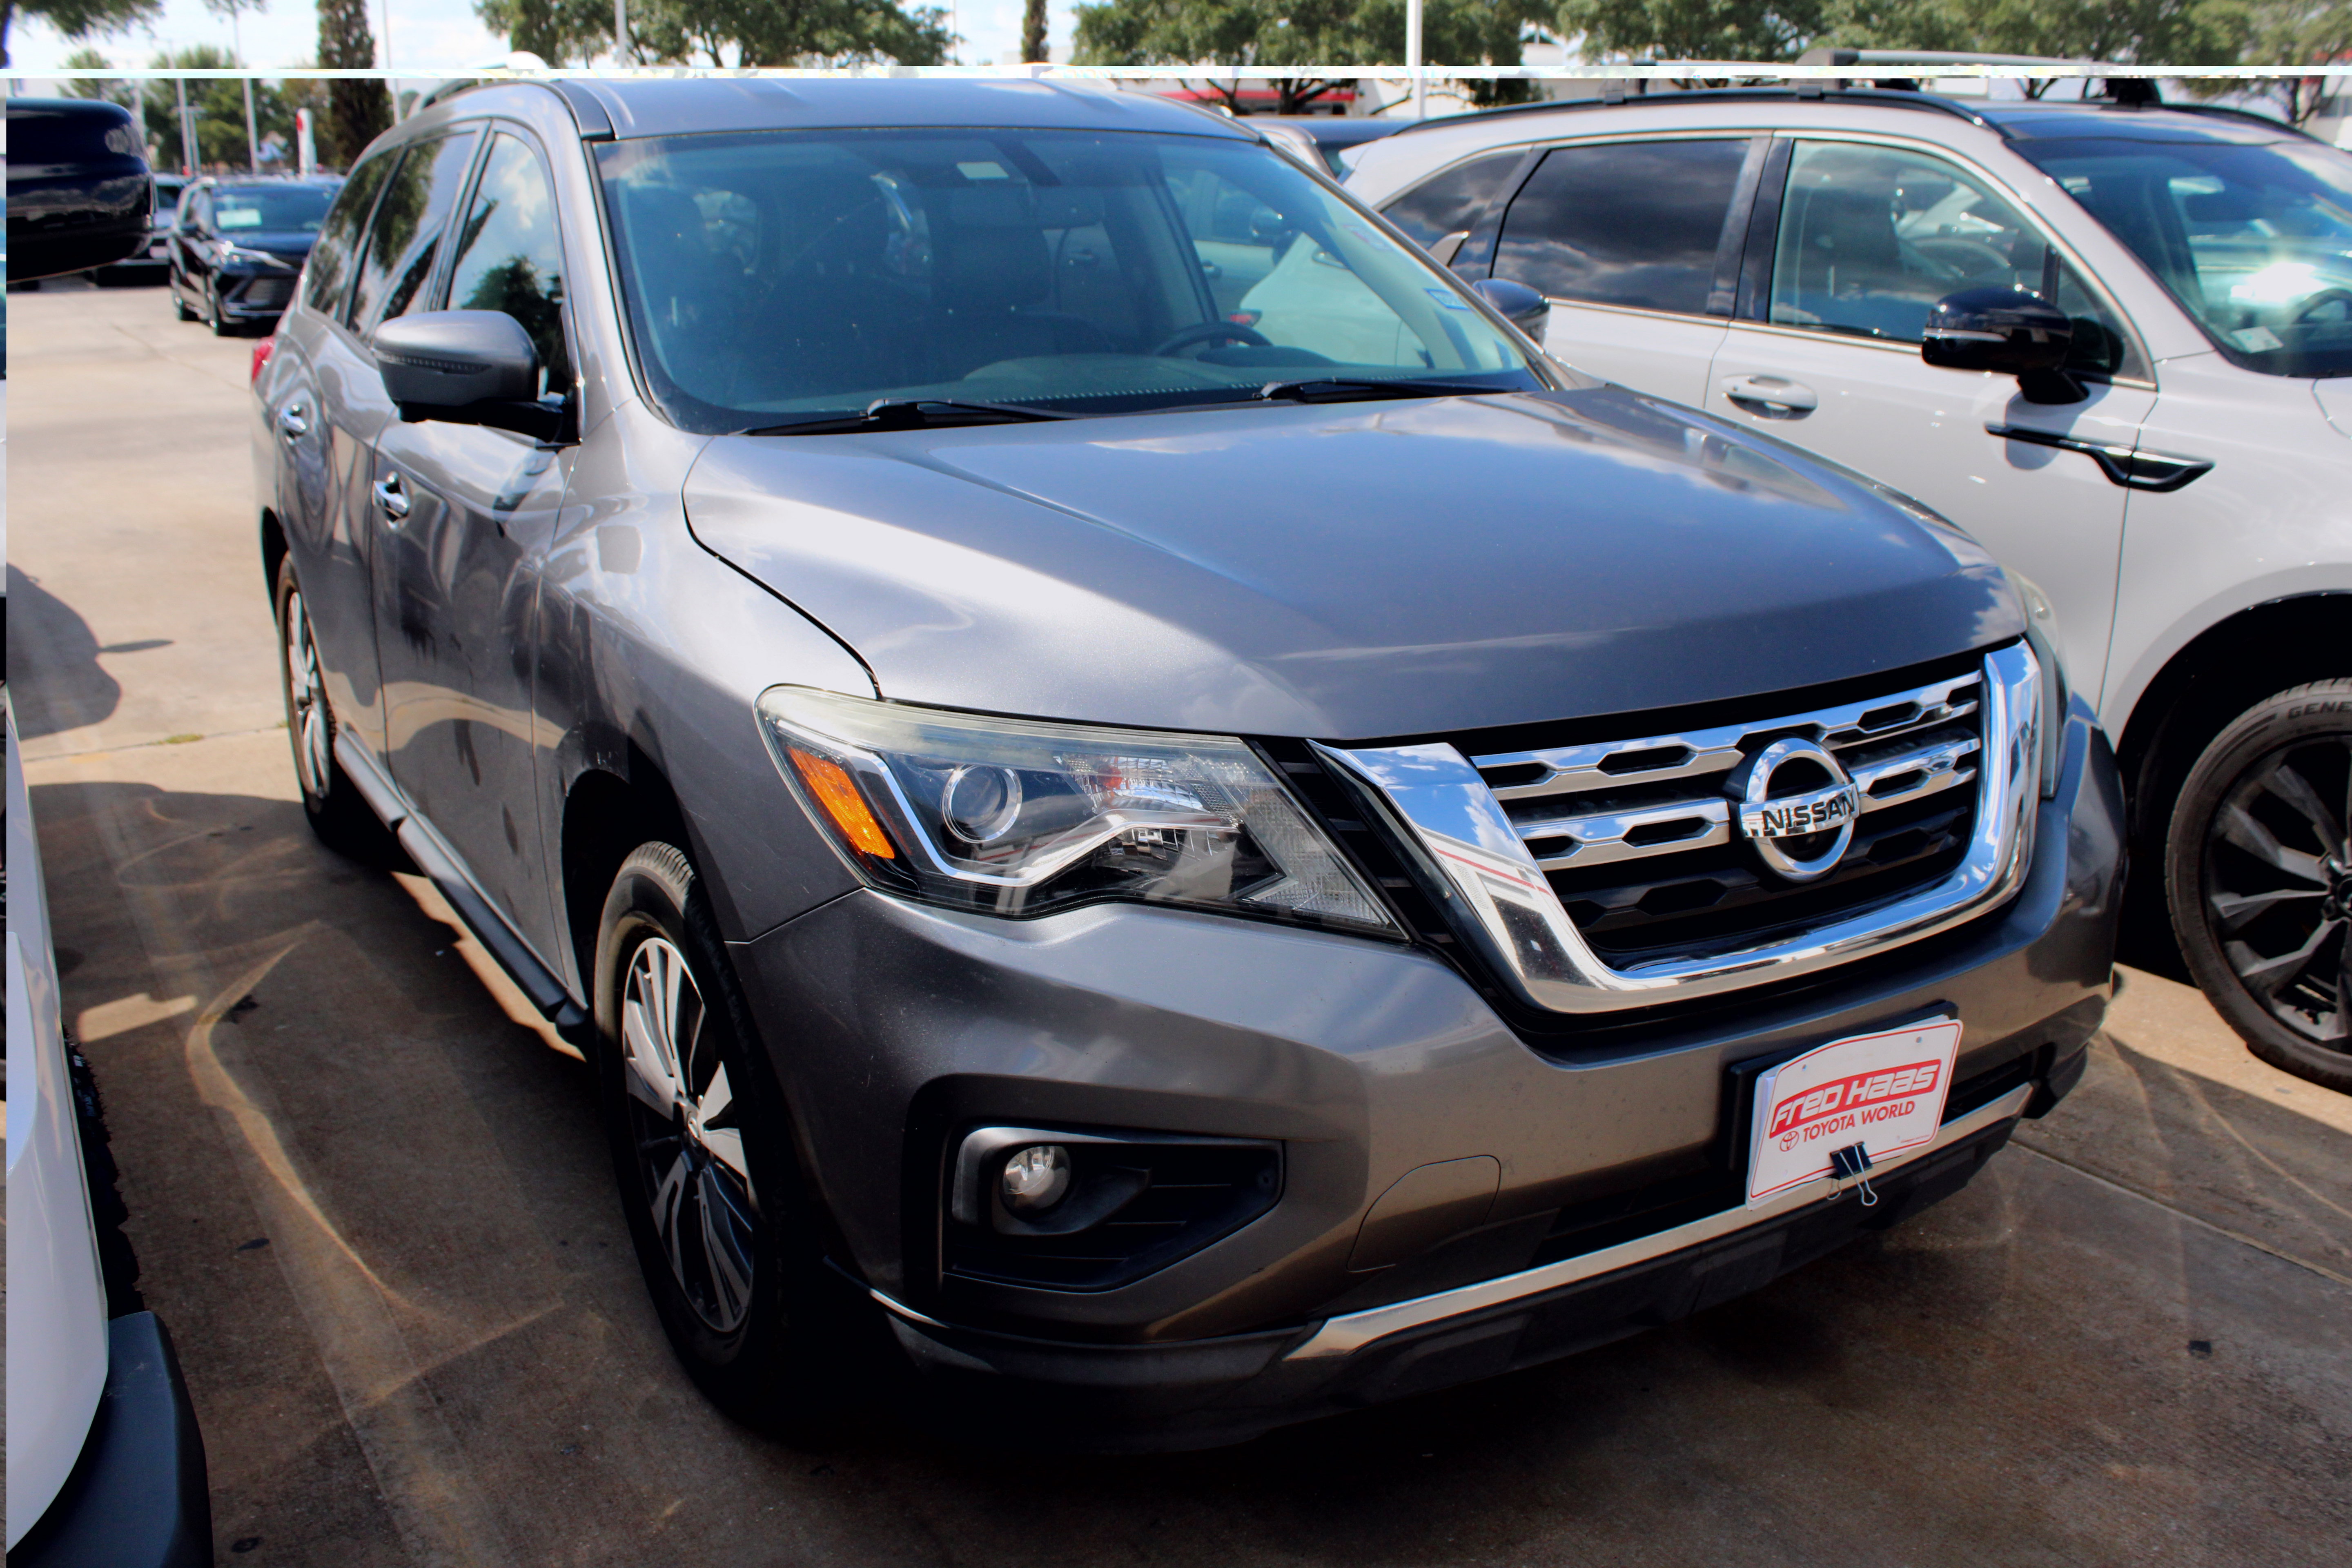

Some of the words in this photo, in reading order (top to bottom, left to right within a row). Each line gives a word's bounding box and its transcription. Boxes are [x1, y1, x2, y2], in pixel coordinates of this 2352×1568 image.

[1762, 790, 1855, 830] NISSAN
[1803, 1114, 1855, 1142] TOYOTA
[1861, 1101, 1915, 1125] WORLD
